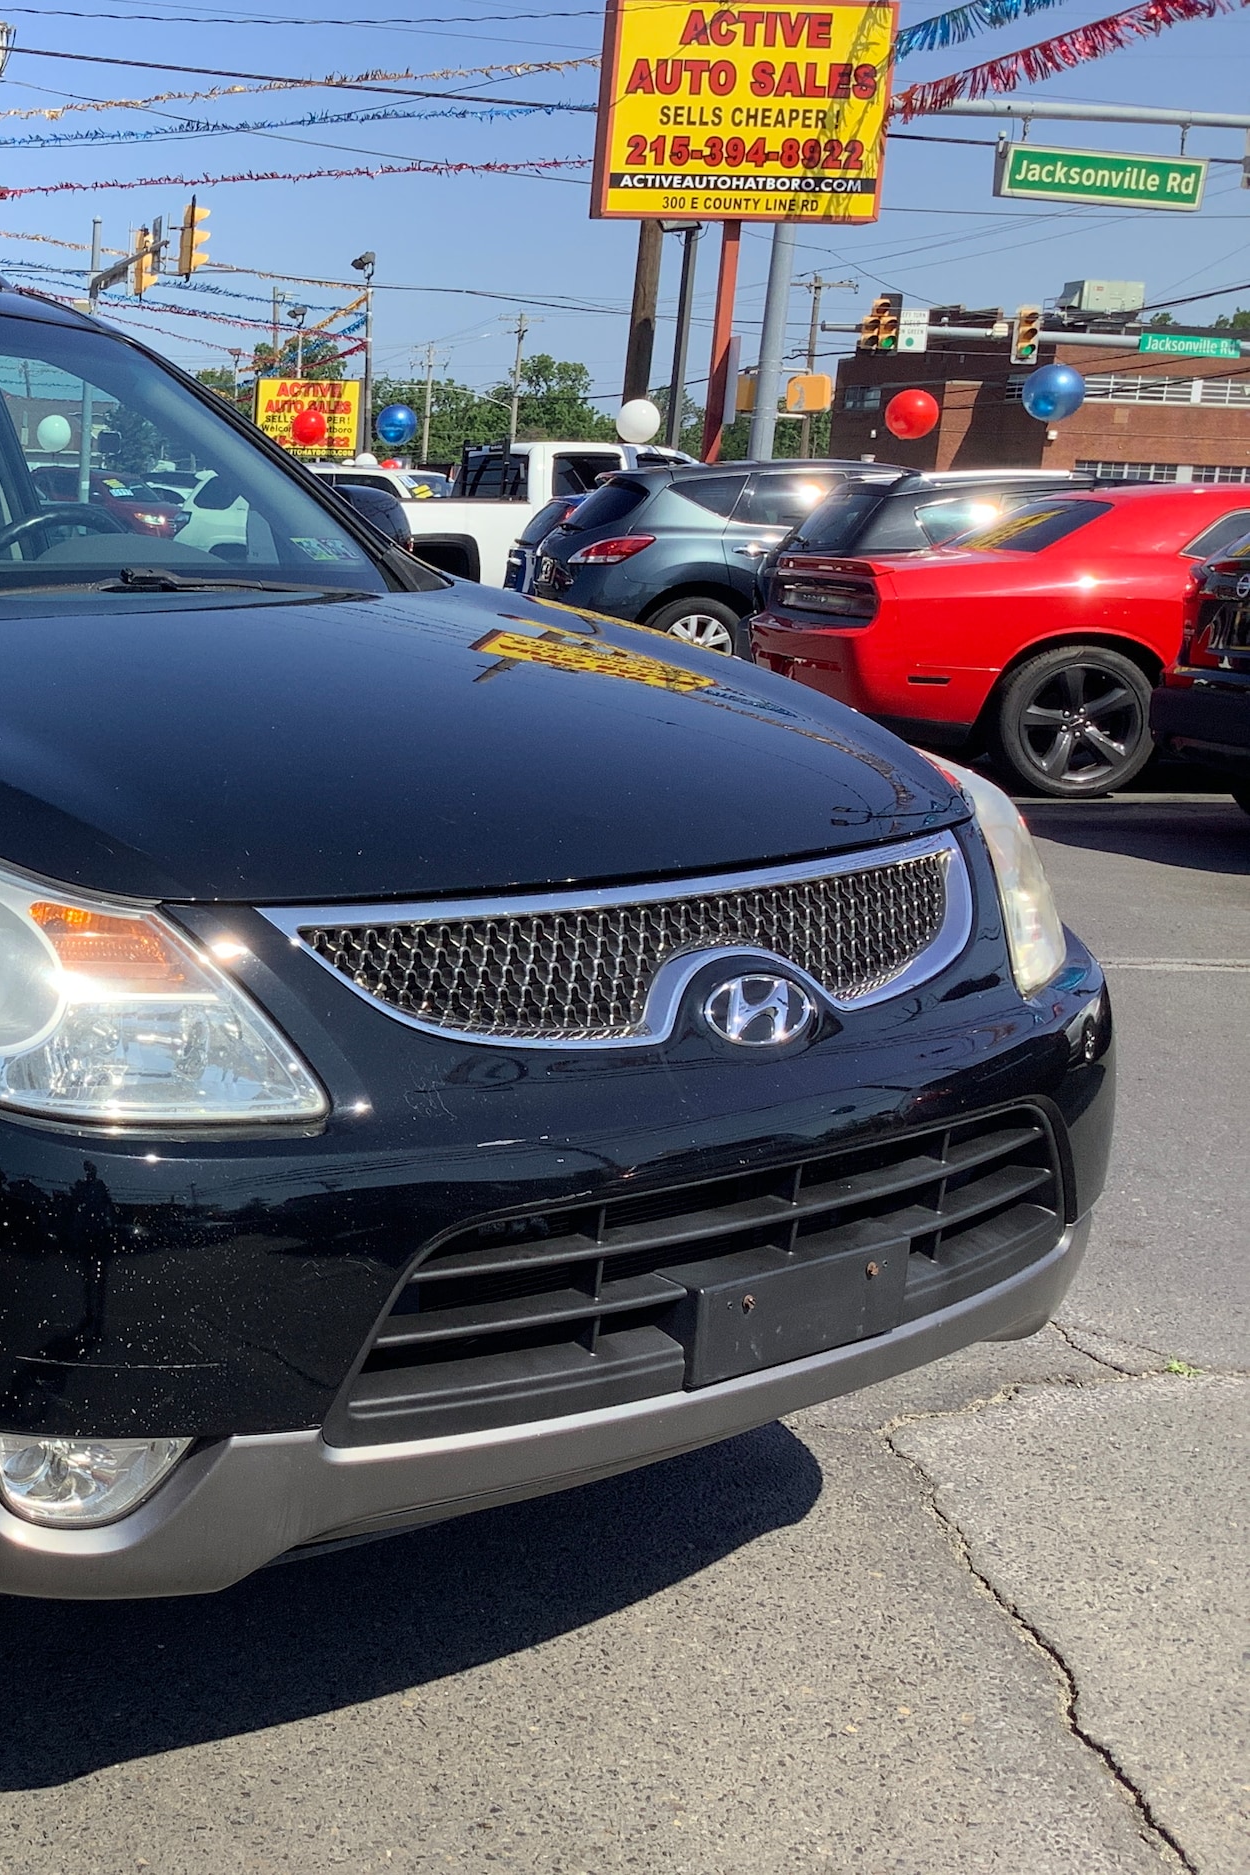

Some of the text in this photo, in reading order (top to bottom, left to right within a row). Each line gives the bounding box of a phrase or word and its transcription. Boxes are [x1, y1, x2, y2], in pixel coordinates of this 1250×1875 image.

[679, 9, 833, 49] ACTIVE
[625, 58, 878, 100] AUTO SALES
[659, 105, 723, 127] SELLS
[731, 107, 827, 129] CHEAPER
[625, 134, 864, 170] 215-394-8922
[619, 173, 862, 193] ACTIVEAUTOHATBORO.COM
[1015, 159, 1196, 194] Jacksonville Rd
[662, 196, 819, 212] 300 E COUNTY LINE RD
[1145, 335, 1218, 354] Jacksonville
[276, 381, 343, 398] ACTIVE
[265, 399, 352, 414] AUTO SALES
[265, 414, 295, 424] SELLS
